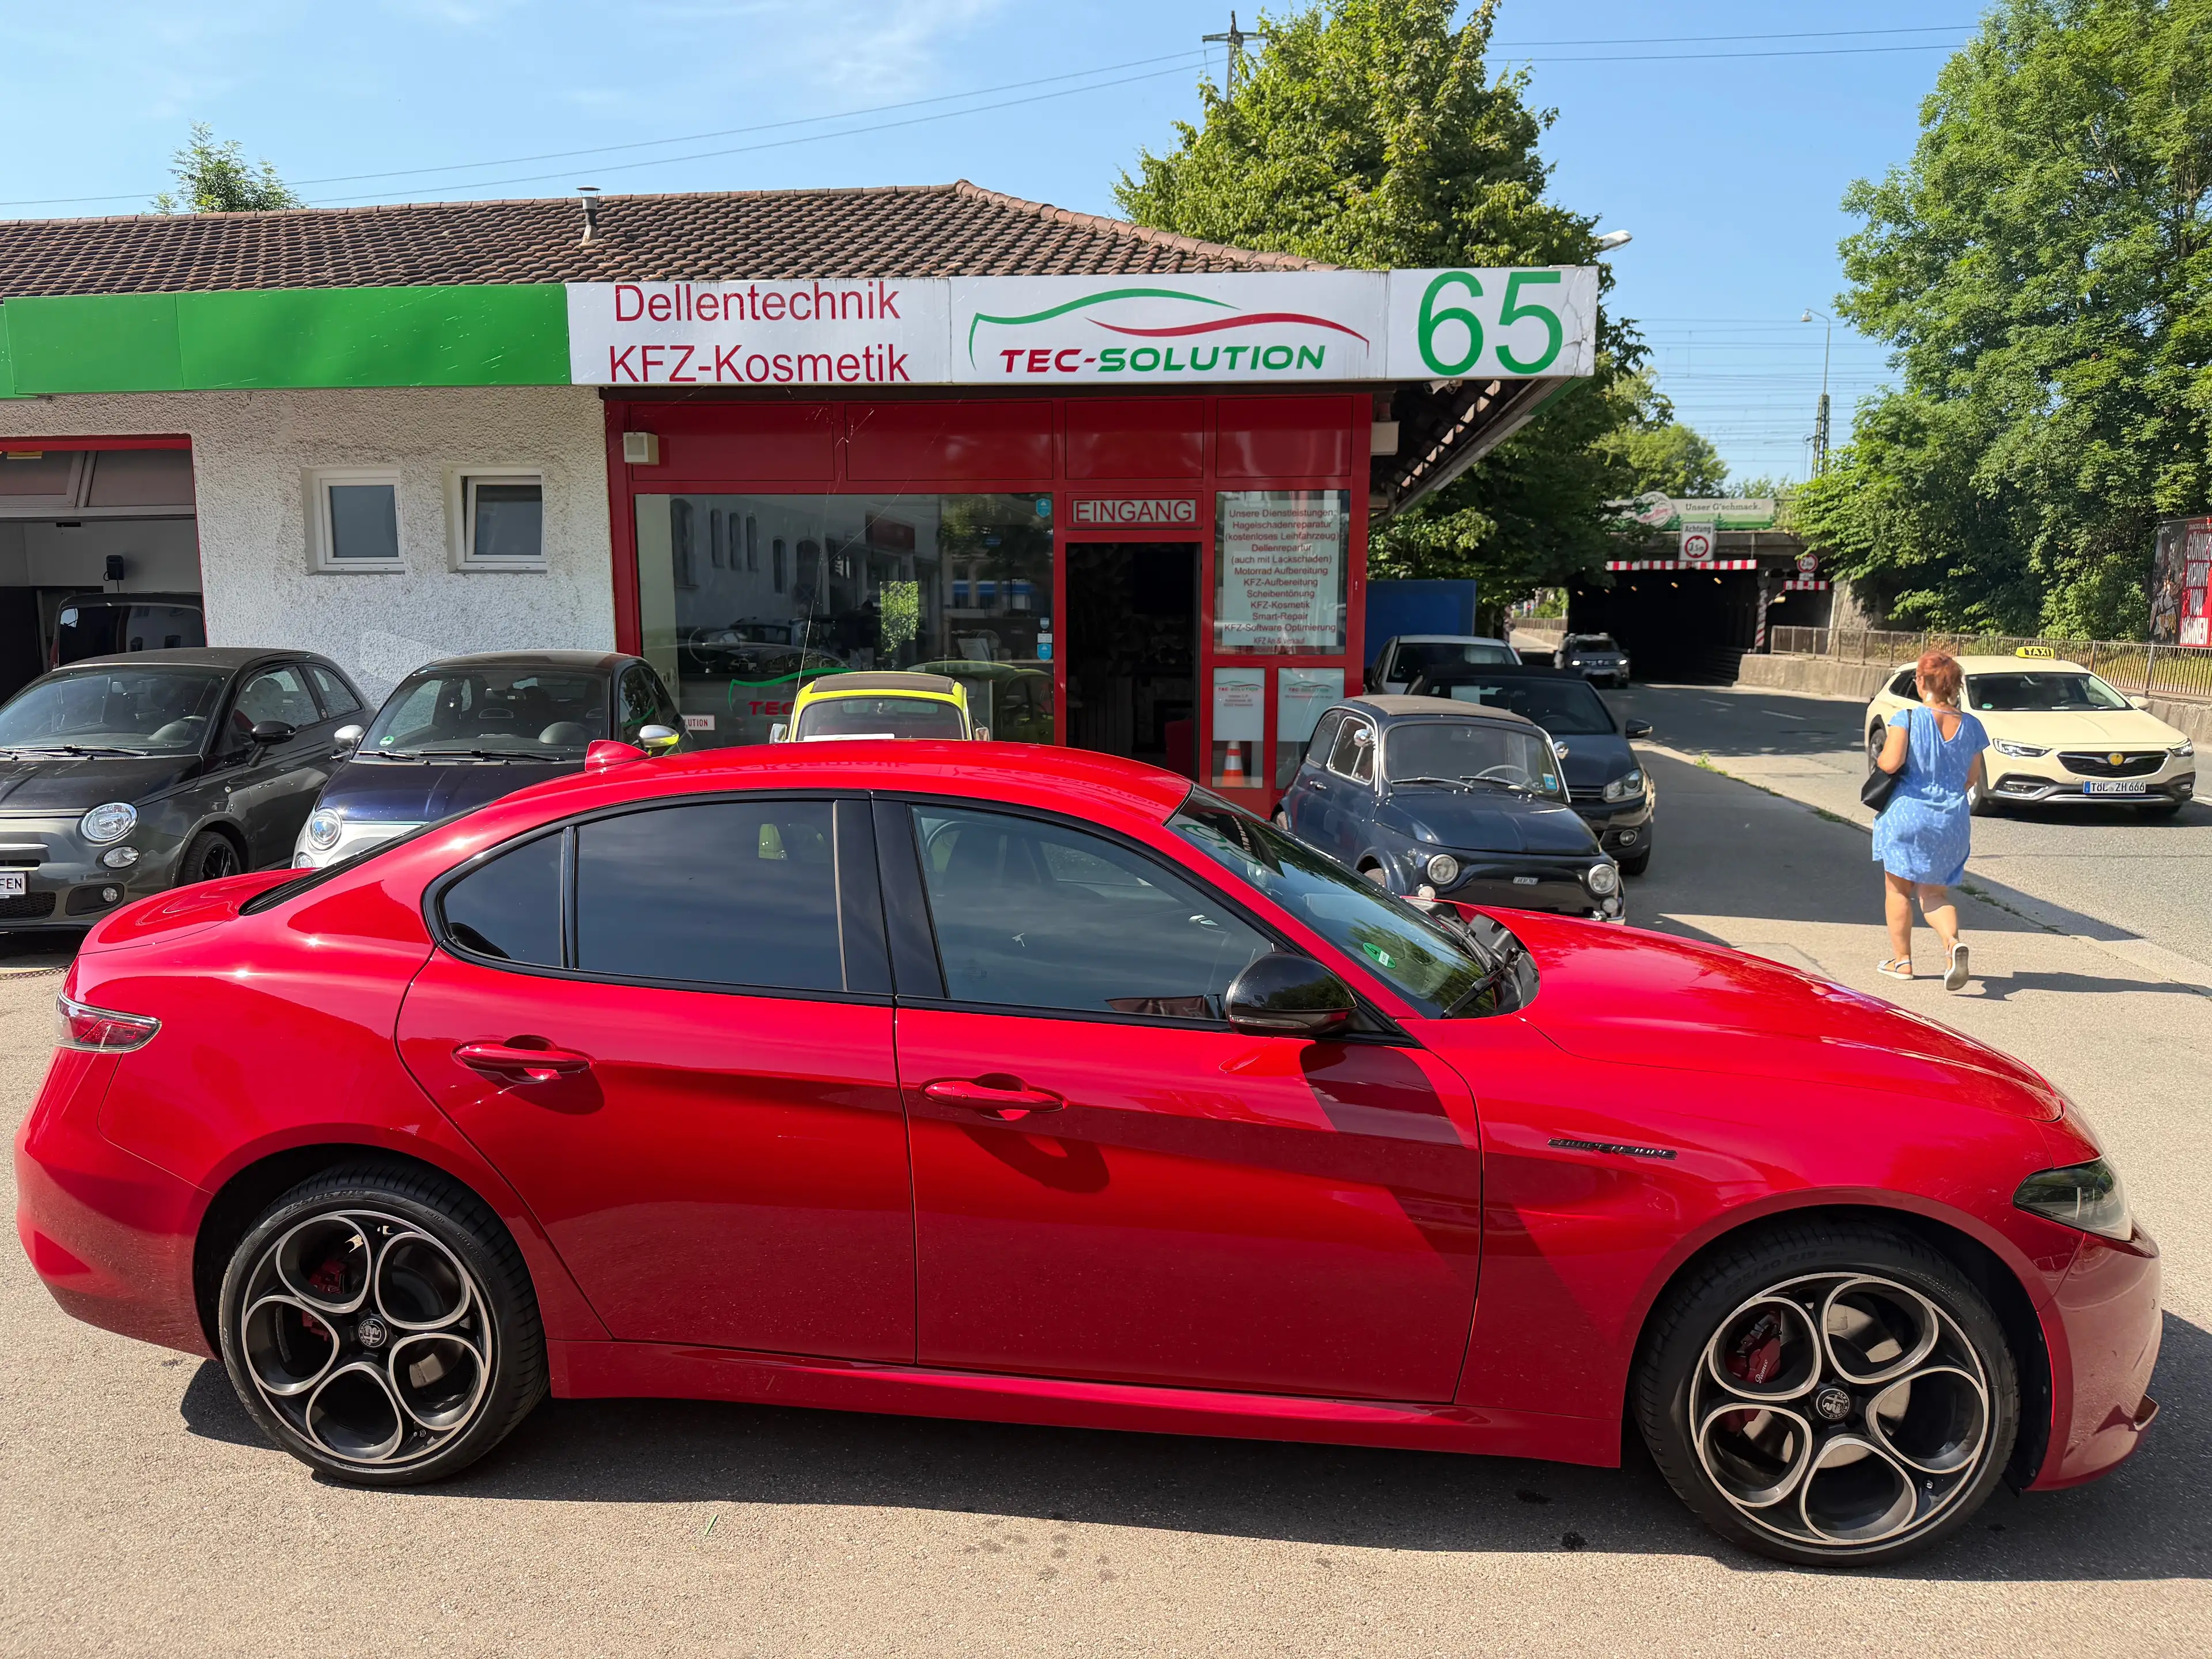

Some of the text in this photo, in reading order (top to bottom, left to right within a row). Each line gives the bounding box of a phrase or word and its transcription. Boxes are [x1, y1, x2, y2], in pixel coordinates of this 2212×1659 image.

[615, 281, 901, 322] Dellentechnik
[1418, 271, 1563, 376] 65
[609, 343, 912, 382] KFZ-Kosmetik
[999, 344, 1325, 373] TEC-SOLUTION
[1076, 501, 1192, 521] EINGANG
[1229, 509, 1259, 517] Unsere
[1233, 521, 1332, 531] Hagelschadenreparatur
[1684, 525, 1711, 534] Achtung
[1225, 531, 1339, 542] (kostenloses Leihfahrzeug)
[1232, 556, 1255, 565] (auch
[1272, 555, 1332, 564] Lackschaden)
[1234, 567, 1328, 575] Motorrad Aufbereitung
[1244, 578, 1318, 587] KFZ-Aufbereitung
[1247, 590, 1315, 599] Scheibentönung
[1251, 601, 1310, 609] KFZ-Kosmetik
[1252, 612, 1308, 622] Smart-Repair
[1225, 623, 1336, 632] KFZ-Software Optimierung
[2180, 615, 2209, 645] KÖNNEN
[2027, 648, 2050, 656] TAXI
[2115, 783, 2127, 791] ZH
[2128, 783, 2145, 791] 666
[1755, 1359, 1768, 1384] Romeo
[1836, 1392, 1849, 1404] ALFA
[1829, 1406, 1848, 1418] ROMEO
